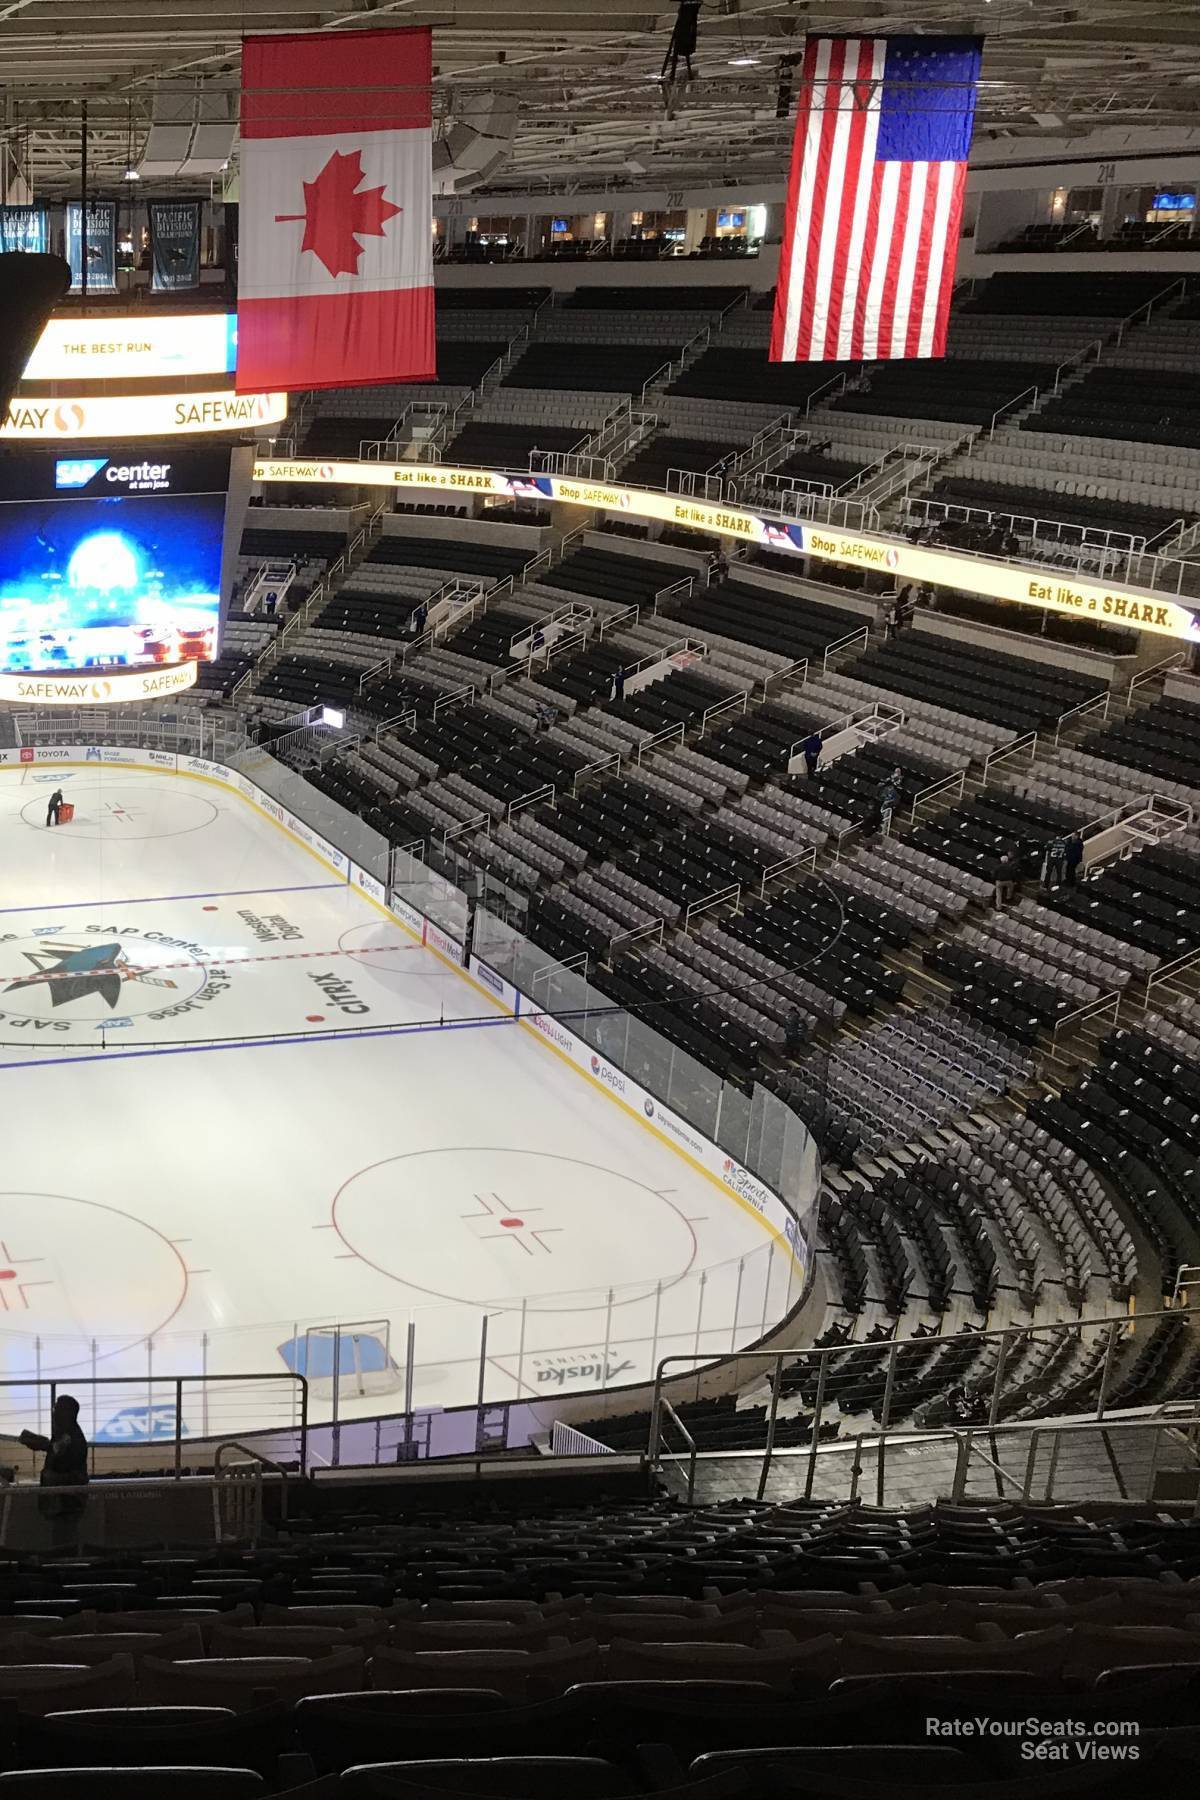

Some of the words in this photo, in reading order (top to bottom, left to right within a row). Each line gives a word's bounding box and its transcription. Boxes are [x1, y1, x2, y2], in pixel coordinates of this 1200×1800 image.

[1097, 164, 1116, 183] 214
[666, 192, 684, 207] 212
[3, 211, 40, 222] PACIFIC
[73, 219, 111, 229] DIISION
[156, 211, 193, 223] PACIFIC
[157, 221, 193, 232] DIVISION
[157, 230, 193, 239] CHAMPIONS
[64, 344, 87, 354] THE
[91, 343, 123, 354] BEST
[127, 342, 152, 353] RUN
[174, 398, 256, 425] SAFEWAY
[105, 461, 171, 482] center
[269, 466, 319, 477] SAFEWAY
[394, 471, 414, 482] Eat
[417, 472, 437, 484] like
[440, 475, 447, 484] a
[129, 481, 138, 489] at
[153, 479, 170, 490] jose
[559, 485, 580, 500] Shop
[583, 487, 619, 505] SAFEWAY
[675, 505, 689, 520] Eat
[690, 507, 706, 524] like
[708, 514, 713, 525] a
[811, 535, 837, 554] Shop
[840, 540, 886, 563] SAFEWAY
[1028, 581, 1054, 602] Eat
[1056, 587, 1084, 610] like
[1088, 597, 1097, 611] a
[1102, 595, 1174, 629] SHARK.
[17, 682, 89, 698] SAFEWAY
[142, 671, 189, 694] SAFEWAY
[37, 750, 70, 758] TOYOTA
[1050, 847, 1065, 858] 27
[236, 909, 280, 943] Western
[261, 913, 305, 942] Digital
[85, 924, 139, 935] SAP
[144, 930, 212, 958] Center
[208, 968, 228, 981] at
[197, 978, 232, 1002] San
[147, 997, 205, 1020] Jose
[9, 1018, 73, 1032] SAP
[554, 1030, 573, 1052] LIGHT
[600, 1065, 626, 1095] pepsi
[722, 1173, 765, 1214] CALIFORNIA
[736, 1168, 770, 1204] Sports
[532, 1350, 619, 1367] AIRLINES
[536, 1359, 638, 1386] Alaska
[107, 1408, 180, 1439] SAP
